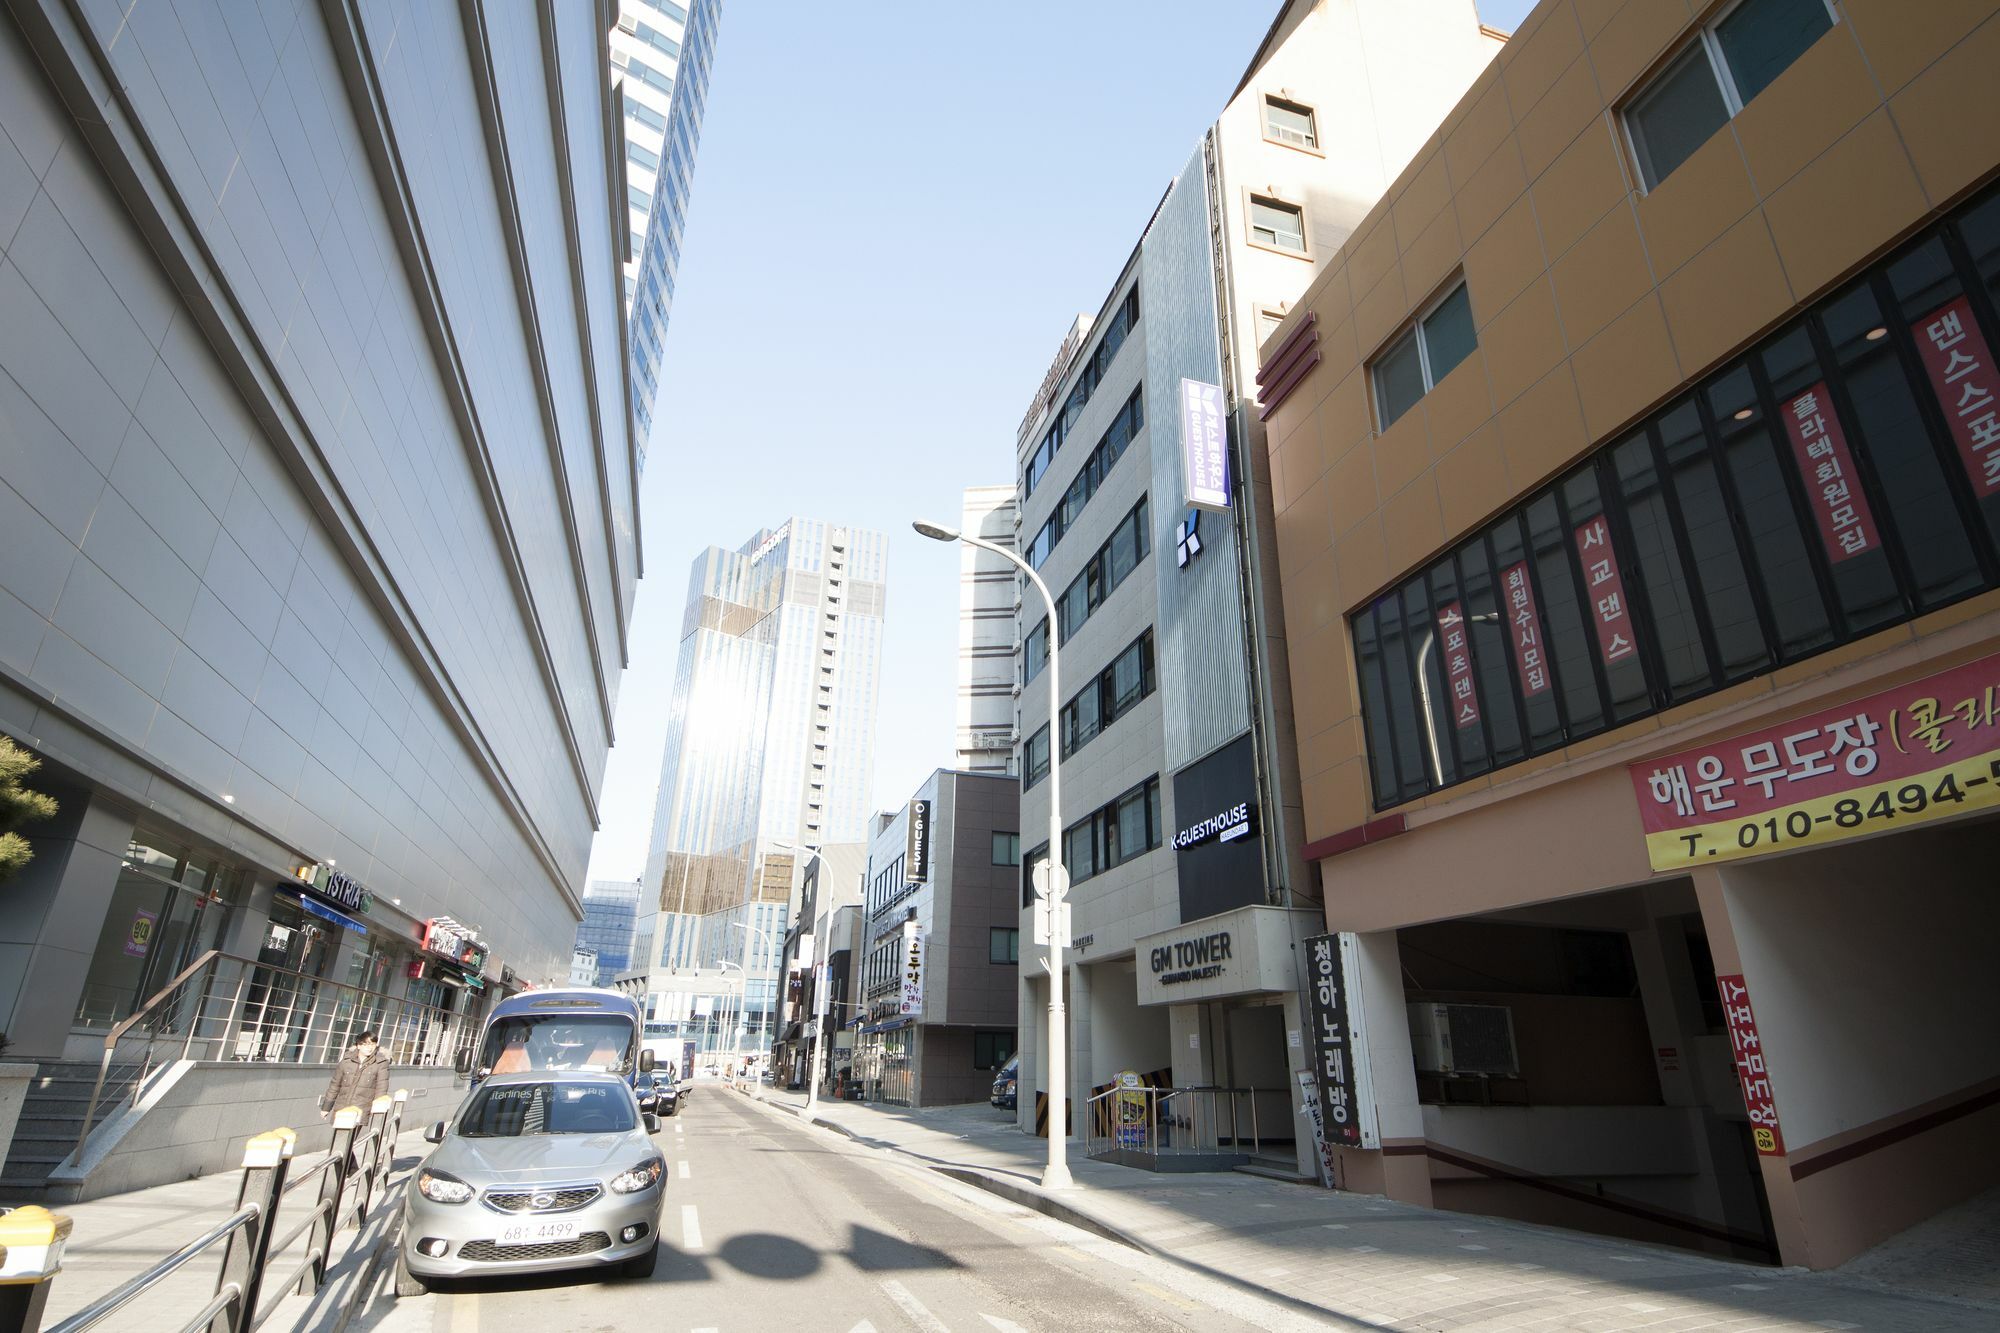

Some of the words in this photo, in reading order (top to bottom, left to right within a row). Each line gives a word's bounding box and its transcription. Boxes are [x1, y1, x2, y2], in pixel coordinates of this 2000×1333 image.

[1191, 412, 1206, 487] GUESTHOUSE
[1583, 521, 1632, 659] 사교댄스
[1441, 609, 1476, 724] 스포츠댄스
[1170, 802, 1248, 851] K-GUESTHOUSE
[134, 921, 150, 941] 임대
[1072, 933, 1094, 949] PARKING
[1150, 945, 1173, 974] GM
[1174, 931, 1232, 969] TOWER
[1721, 980, 1778, 1128] 스포츠무도장
[489, 1089, 533, 1102] itadines
[538, 1222, 573, 1238] 4499
